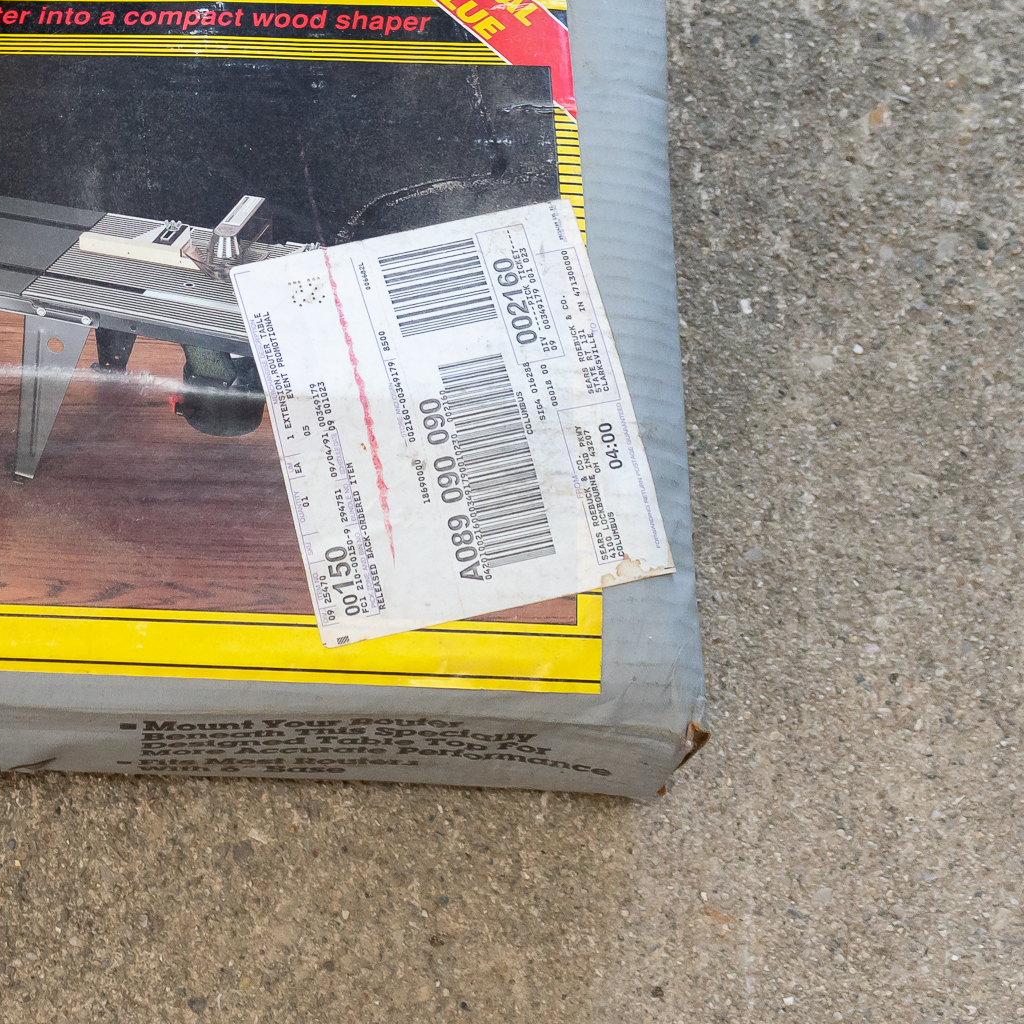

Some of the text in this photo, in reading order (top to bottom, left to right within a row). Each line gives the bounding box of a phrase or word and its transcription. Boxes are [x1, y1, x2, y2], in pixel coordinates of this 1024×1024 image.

[38, 6, 91, 26] into
[98, 10, 115, 25] a
[123, 8, 243, 31] compact
[253, 10, 328, 29] wood
[335, 10, 432, 36] shaper
[493, 256, 537, 344] 002160
[525, 267, 550, 329] 00349179 001
[253, 312, 267, 339] TABLE
[560, 250, 609, 391] CLARKSVILLE 471300000
[263, 311, 294, 399] EVENT PROMOTIONAL
[538, 336, 550, 352] DIV
[568, 325, 594, 394] SEARS ROEBUCK
[577, 328, 602, 393] STATE 131
[316, 381, 331, 414] 001023
[378, 330, 415, 442] 002160-00349179 8500
[522, 361, 538, 393] 016288
[301, 424, 311, 436] 05
[515, 391, 533, 434] COLUMBUS
[293, 461, 302, 474] EA
[598, 422, 622, 469] 04:00
[309, 383, 363, 590] 210-00150-9 294751 09/04/91 00349179
[412, 459, 430, 503] 18690000
[419, 398, 483, 580] A089 090 090
[574, 425, 616, 558] 4100 LOCKBOURNE IND PKWY
[582, 429, 625, 557] COLUMBUS 43207
[292, 490, 305, 523] QUANTITY
[583, 487, 608, 560] SEARS ROEBUCK
[344, 462, 385, 610] RELEASED BACK-ORDERED ITEM
[318, 575, 332, 603] 25470
[324, 546, 360, 616] 00150
[326, 609, 335, 621] 09
[141, 736, 552, 755] Designed Table Top For
[142, 727, 538, 742] Beneath This Specially
[143, 717, 464, 731] Mount Your Router
[140, 746, 612, 776] More Accurate Performance
